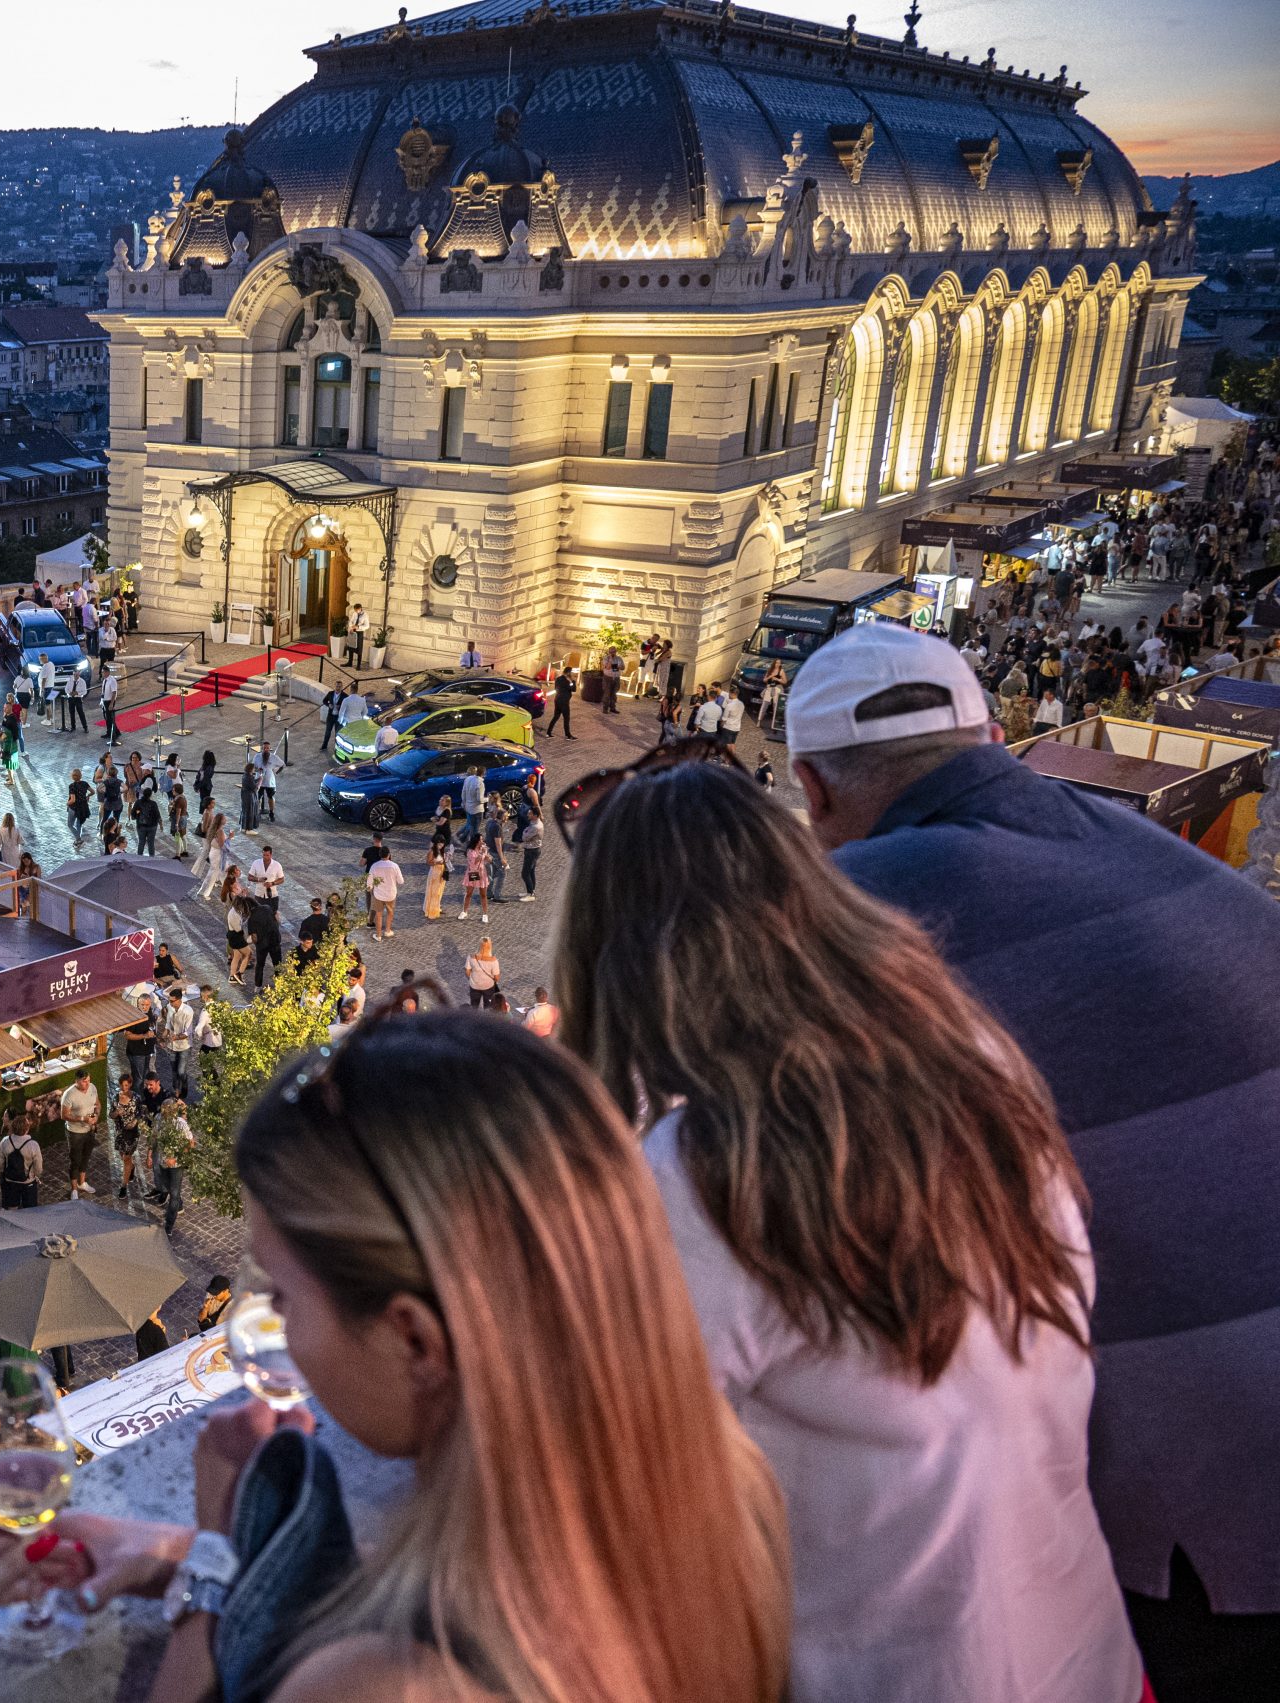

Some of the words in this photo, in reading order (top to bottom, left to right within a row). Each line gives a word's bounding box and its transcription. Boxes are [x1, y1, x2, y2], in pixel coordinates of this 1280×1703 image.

[1231, 712, 1243, 720] 64
[1210, 725, 1231, 733] NATURE
[1251, 732, 1274, 740] DOSAGE
[50, 971, 92, 993] FÜLEKY
[50, 983, 89, 1001] TOKAJ
